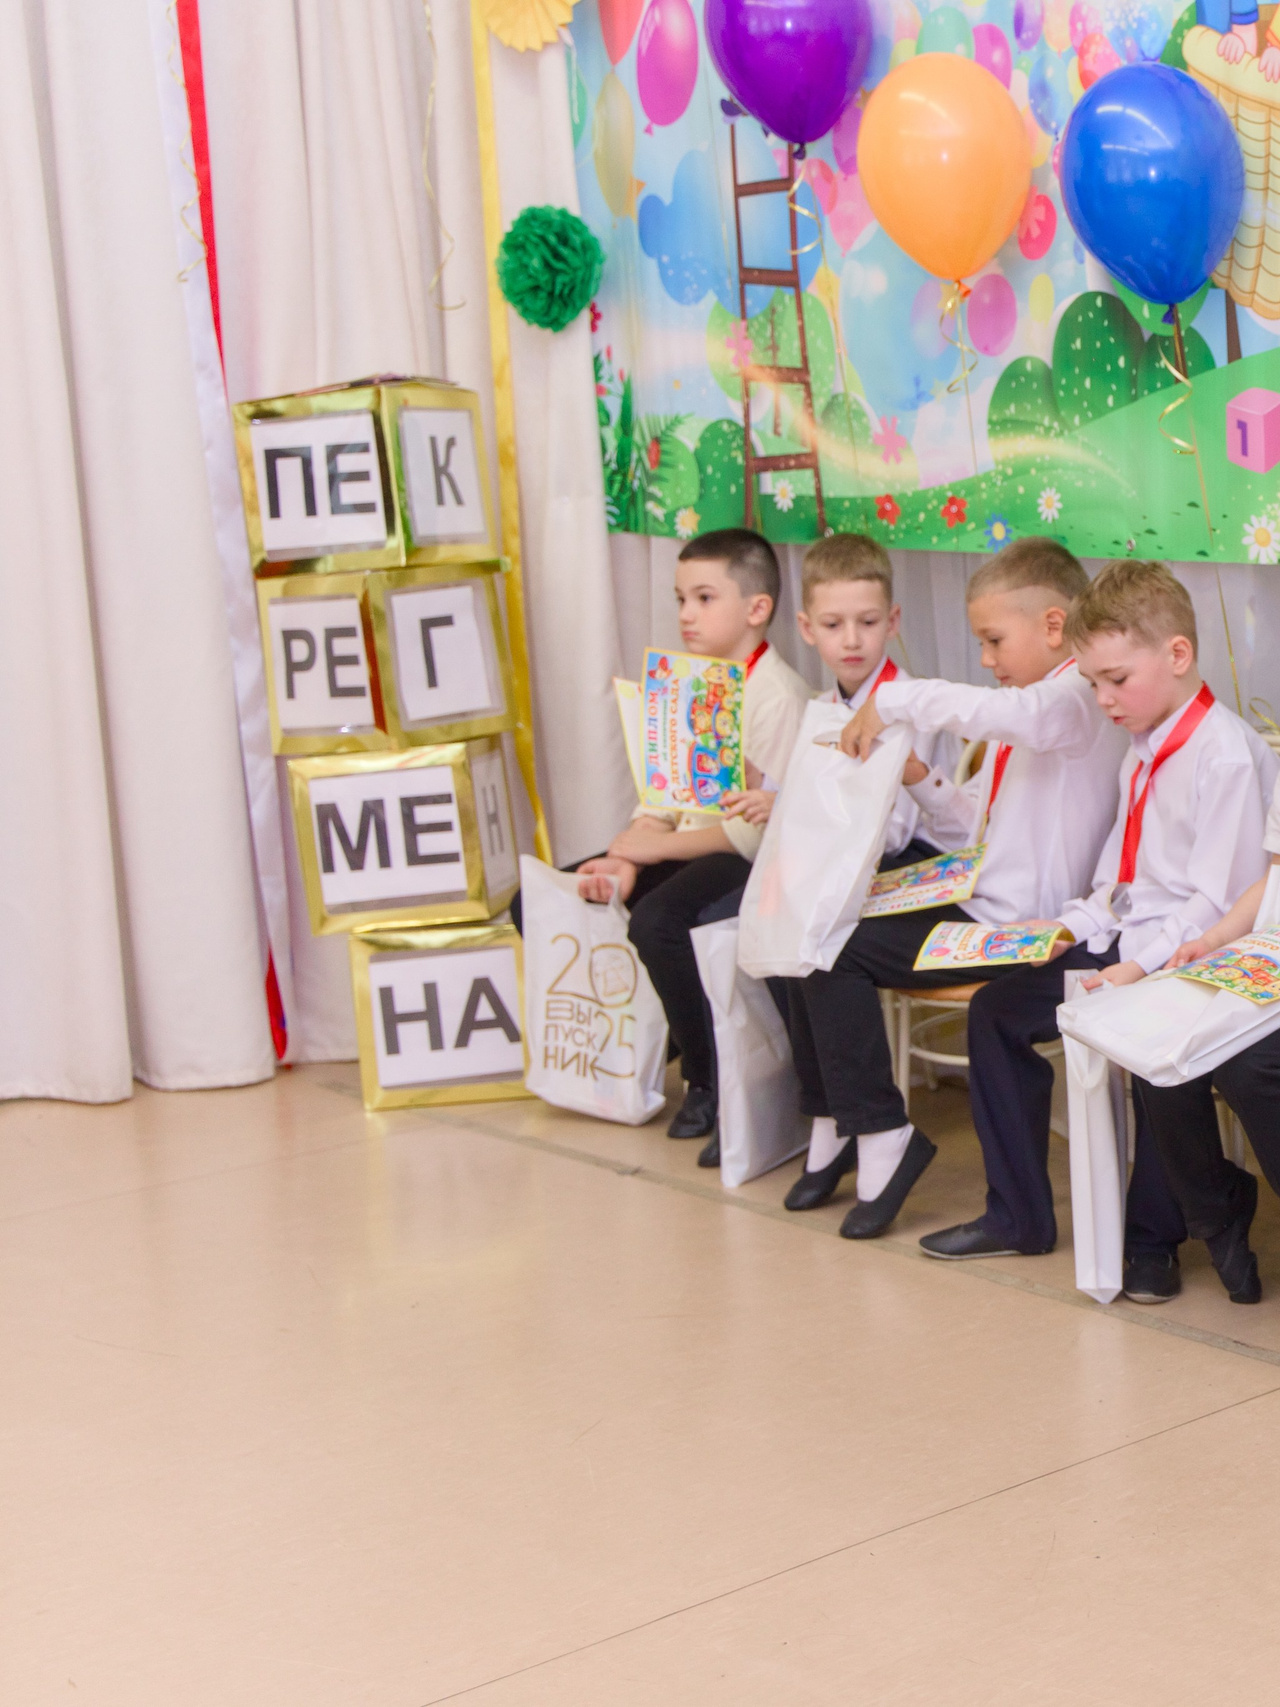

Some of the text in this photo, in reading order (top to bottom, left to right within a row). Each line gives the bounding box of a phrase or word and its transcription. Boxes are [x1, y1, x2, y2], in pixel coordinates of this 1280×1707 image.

[428, 435, 465, 507] К
[1236, 419, 1249, 458] 1
[263, 441, 377, 519] ПЕ
[281, 626, 366, 700] РЕ
[419, 614, 454, 689] Г
[669, 678, 680, 715] САДА
[313, 792, 460, 874] МЕ
[481, 783, 505, 857] Н
[378, 976, 521, 1056] НА
[544, 1023, 598, 1050] ПУСК
[545, 999, 592, 1026] ВЫ
[544, 1045, 600, 1082] НИК
